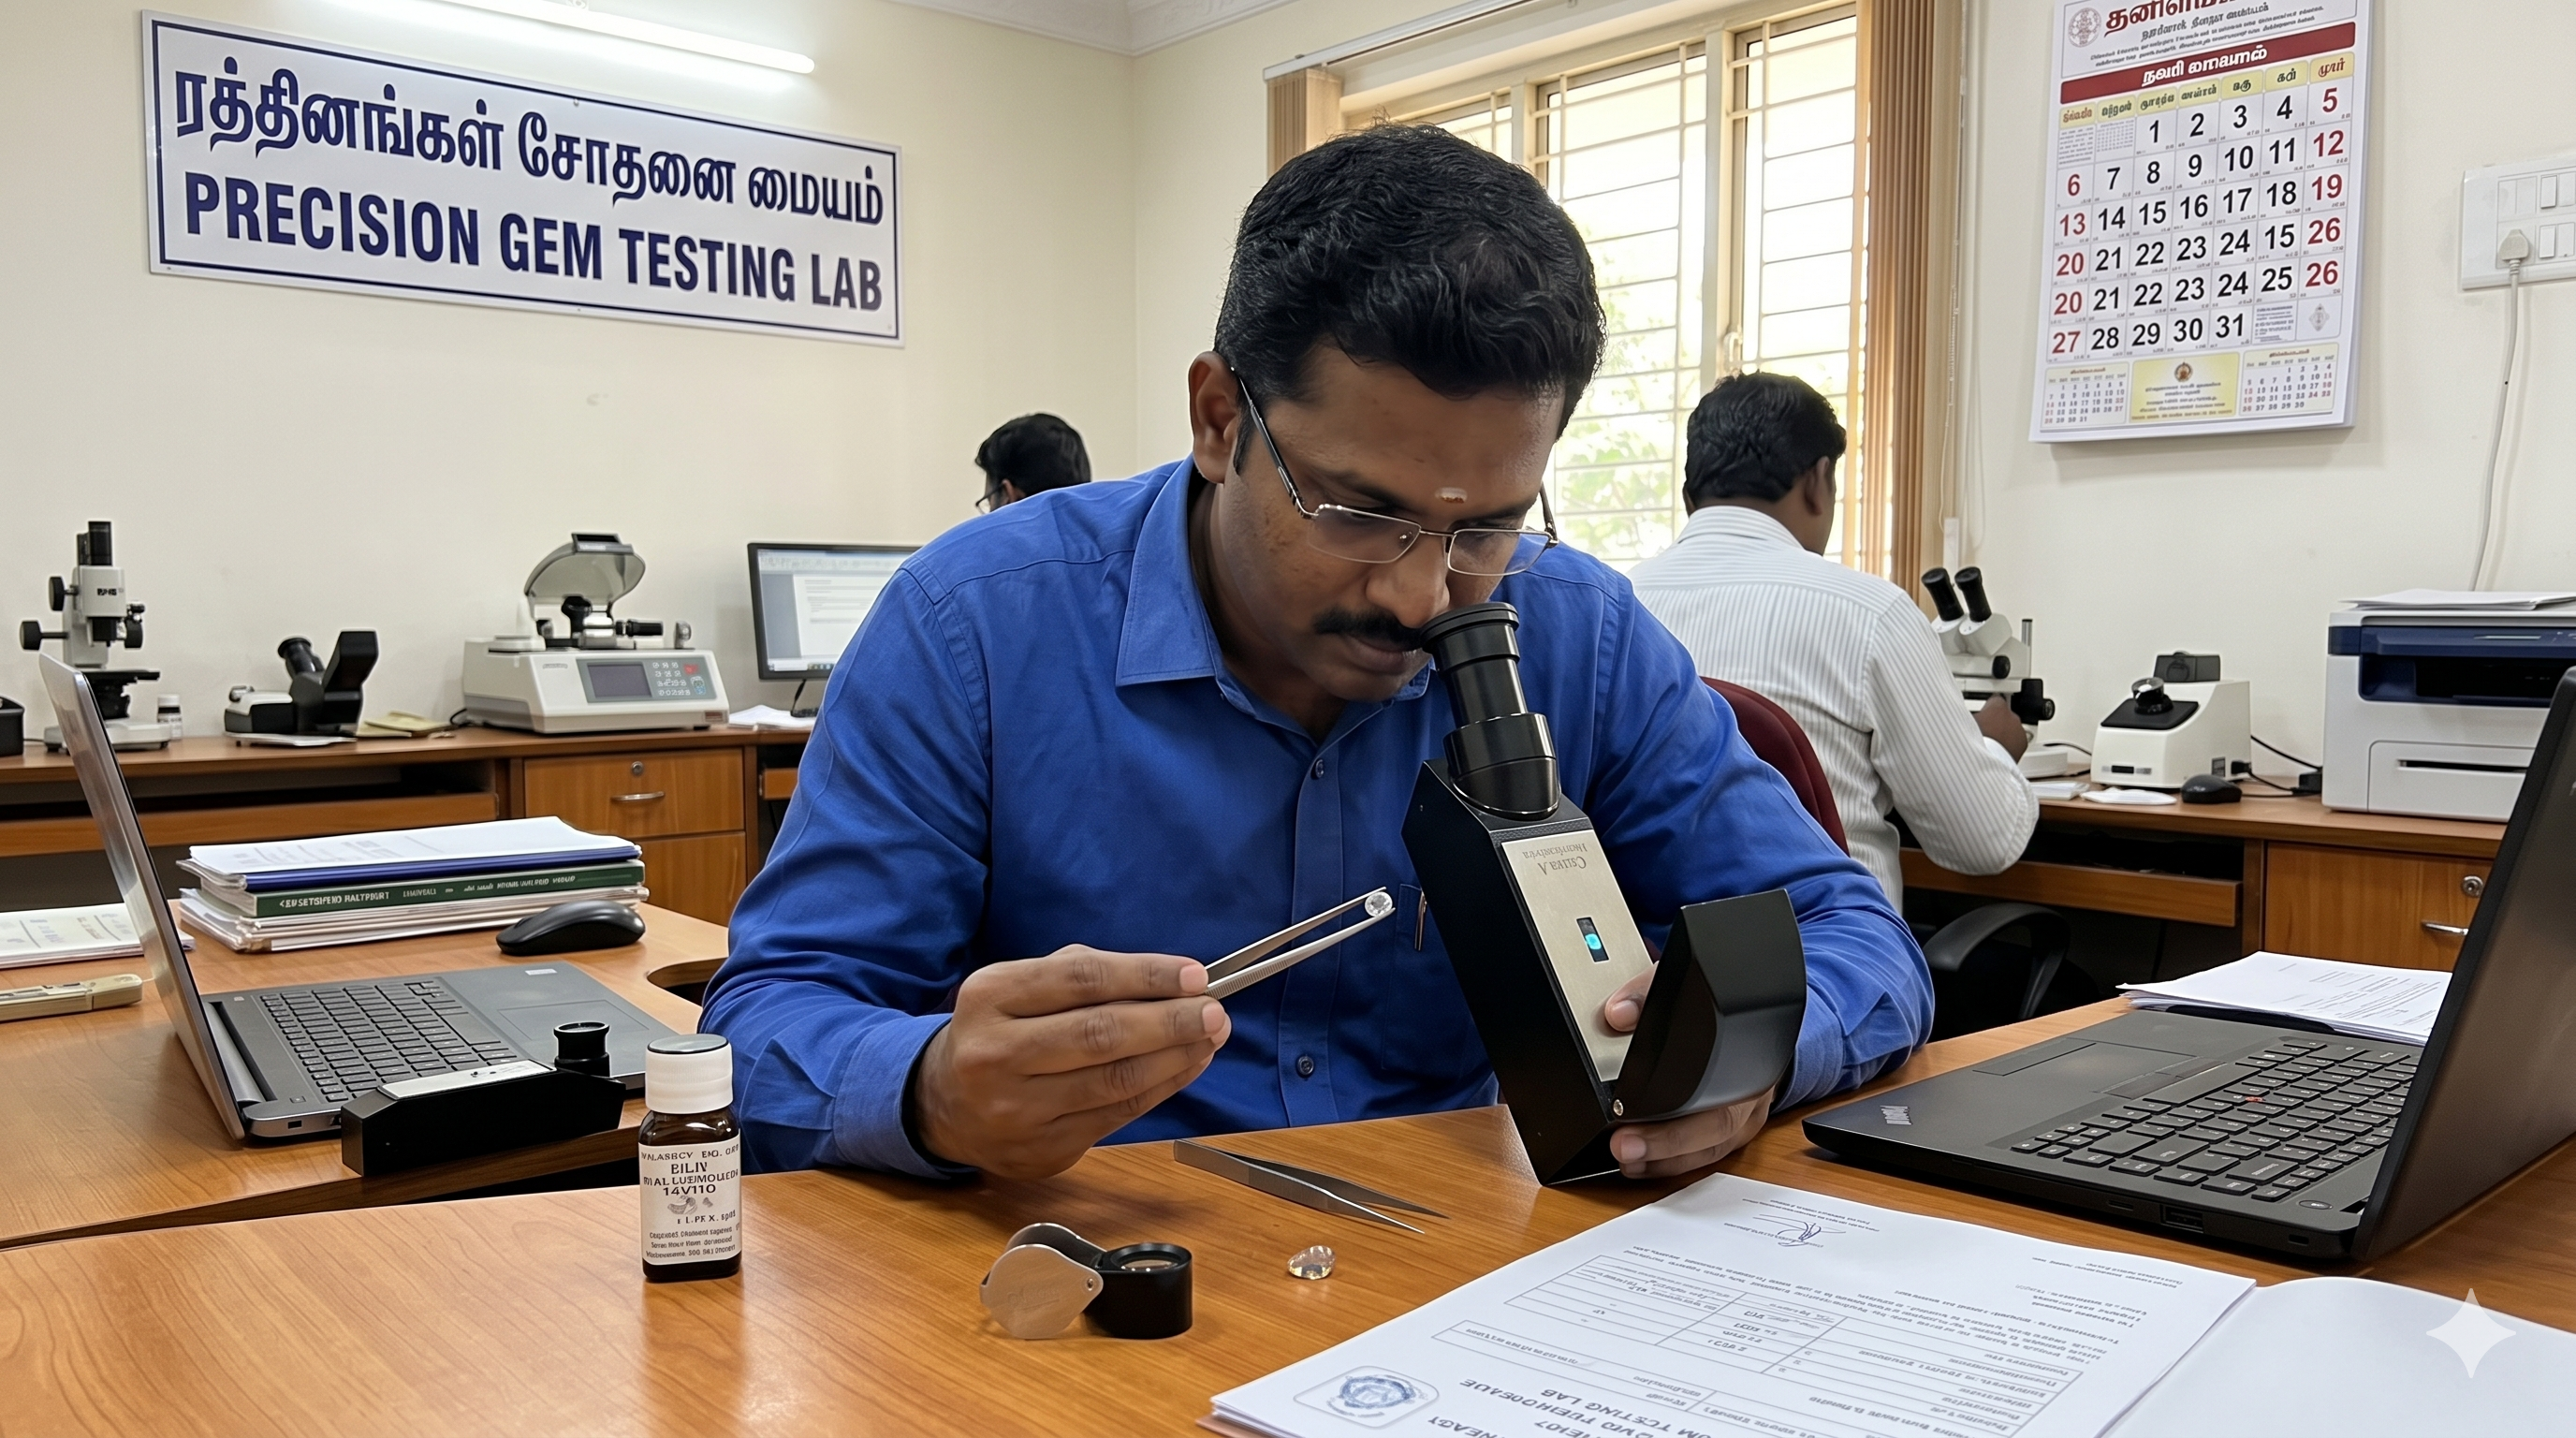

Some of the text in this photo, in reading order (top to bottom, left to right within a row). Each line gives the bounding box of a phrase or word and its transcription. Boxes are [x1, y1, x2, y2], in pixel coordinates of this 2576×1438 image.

[174, 55, 884, 226] ரத்தினங்கள் சோதனை மையம்
[2150, 120, 2159, 142] 1
[2190, 113, 2203, 137] 2
[2233, 105, 2247, 128] 3
[2277, 95, 2292, 119] 4
[2323, 88, 2337, 112] 5
[2068, 130, 2343, 196] 6 7 8 9 10 11 12
[2060, 174, 2342, 235] 13 14 15 16 17 18 19
[184, 171, 883, 313] PRECISION GEM TESTING LAB
[2056, 218, 2340, 276] 20 21 22 23 24 15 26
[2055, 261, 2337, 315] 20 21 22 23 24 25 26
[2053, 331, 2080, 353] 27
[2091, 327, 2118, 350] 28
[2132, 323, 2159, 346] 29
[2174, 318, 2203, 342] 30
[2216, 314, 2243, 338] 31
[1540, 1388, 1583, 1405] LAB
